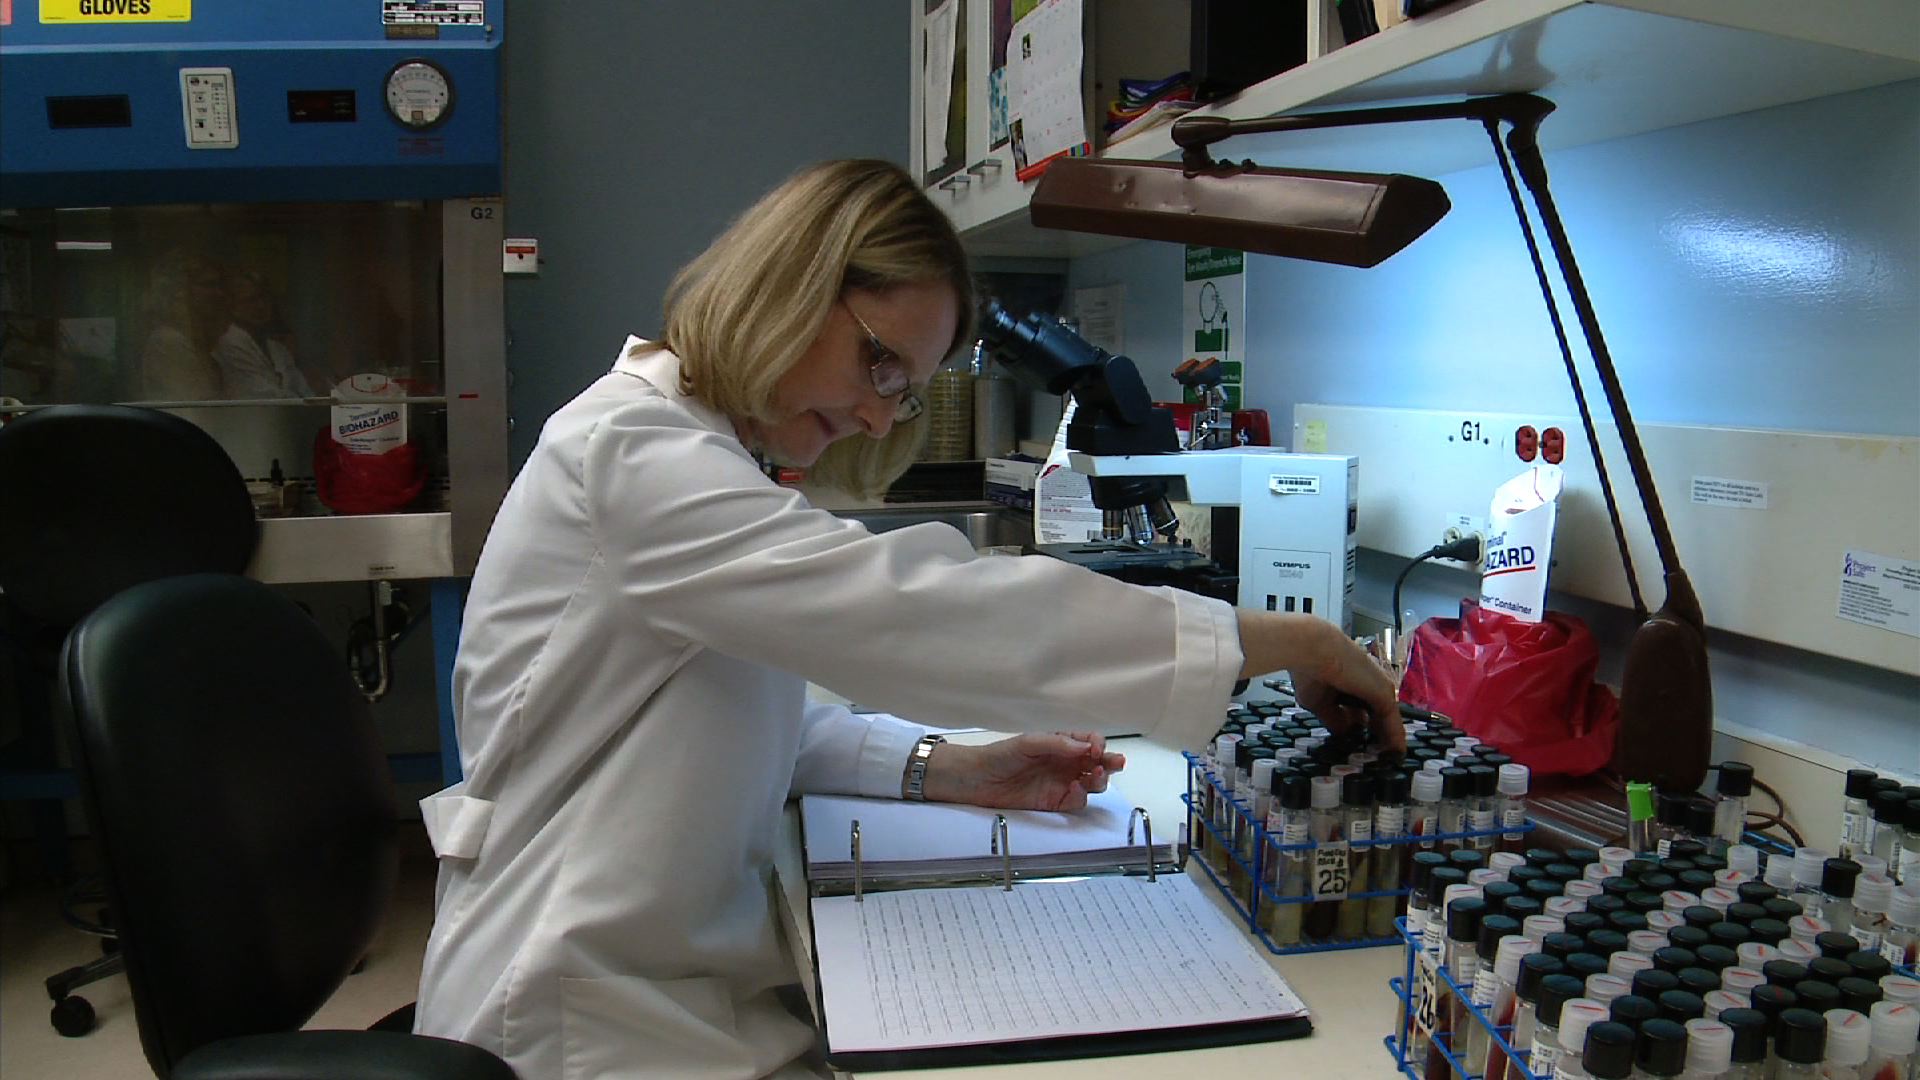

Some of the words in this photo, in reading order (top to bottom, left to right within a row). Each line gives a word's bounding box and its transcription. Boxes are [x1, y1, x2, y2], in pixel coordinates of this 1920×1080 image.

[80, 0, 151, 15] GLOVES
[471, 206, 494, 219] G2
[339, 411, 399, 434] BIOHAZARD
[1461, 420, 1480, 441] G1
[1272, 561, 1311, 569] OLYMPUS
[1494, 597, 1532, 614] Container
[1318, 869, 1347, 895] 25
